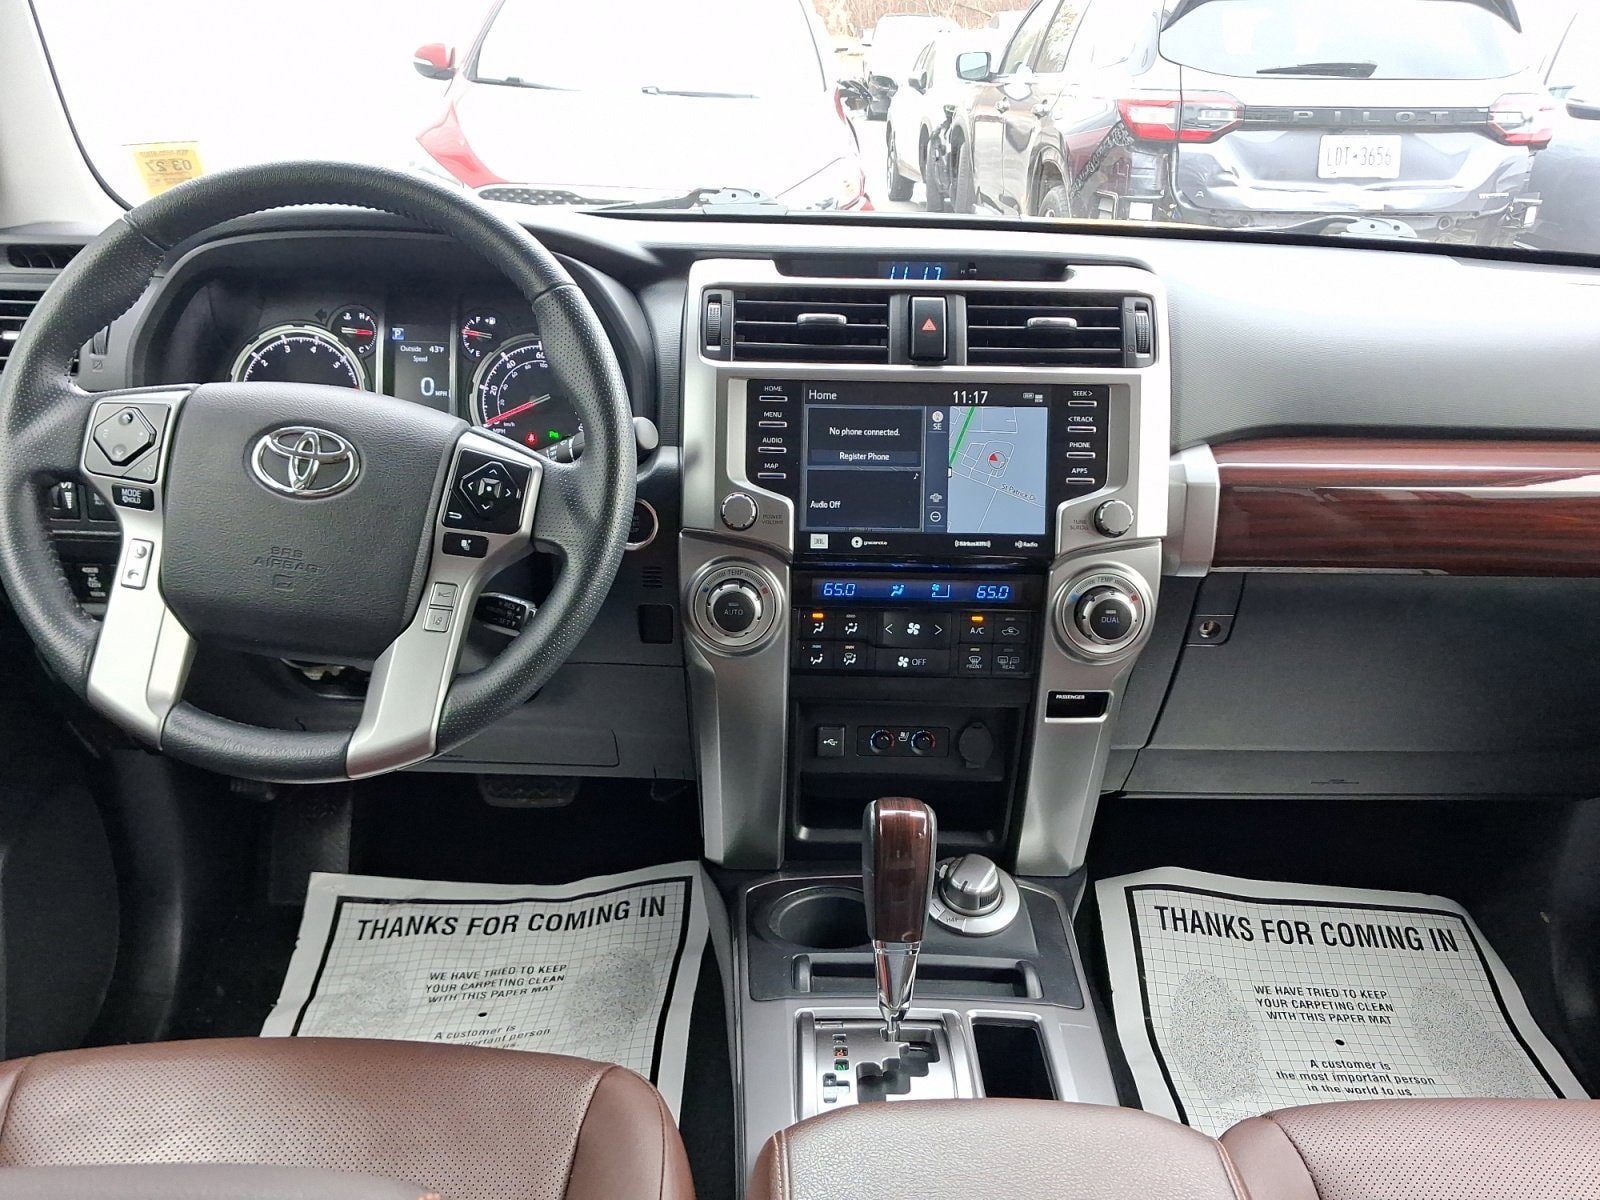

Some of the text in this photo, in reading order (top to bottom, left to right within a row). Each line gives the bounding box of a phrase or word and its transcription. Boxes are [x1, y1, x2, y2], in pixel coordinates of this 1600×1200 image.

[1293, 111, 1448, 122] PILOT
[1360, 147, 1392, 166] 3656
[284, 345, 291, 353] 3
[506, 360, 516, 368] 40
[421, 377, 434, 396] 0
[490, 385, 498, 396] 20
[808, 390, 838, 400] Home
[952, 390, 988, 404] 11:17
[829, 427, 900, 437] No phone connected.
[839, 452, 890, 461] Register Phone
[122, 488, 141, 498] MODE
[823, 583, 856, 596] 65.0
[976, 585, 1010, 599] 65.0
[357, 896, 666, 940] THANKS FOR COMING IN
[1154, 906, 1459, 952] THANKS FOR COMING IN
[430, 964, 567, 980] WE HAVE TRIED TO KEEP
[426, 975, 565, 993] YOUR CARPETING CLEAN
[428, 985, 556, 1003] WITH THIS PAPER MAT
[1254, 986, 1387, 999] WE HAVE TRIED TO KEEP
[1256, 998, 1394, 1012] YOUR CARPETING CLEAN
[1266, 1011, 1392, 1025] WITH THIS PAPER MAT
[434, 1032, 442, 1040] A
[446, 1028, 502, 1039] customer
[509, 1029, 550, 1040] person
[1310, 1059, 1391, 1070] A customer is
[1276, 1071, 1436, 1085] the most important person
[1307, 1084, 1318, 1092] in
[1321, 1084, 1341, 1093] the
[1344, 1086, 1378, 1096] world
[1382, 1087, 1394, 1096] to
